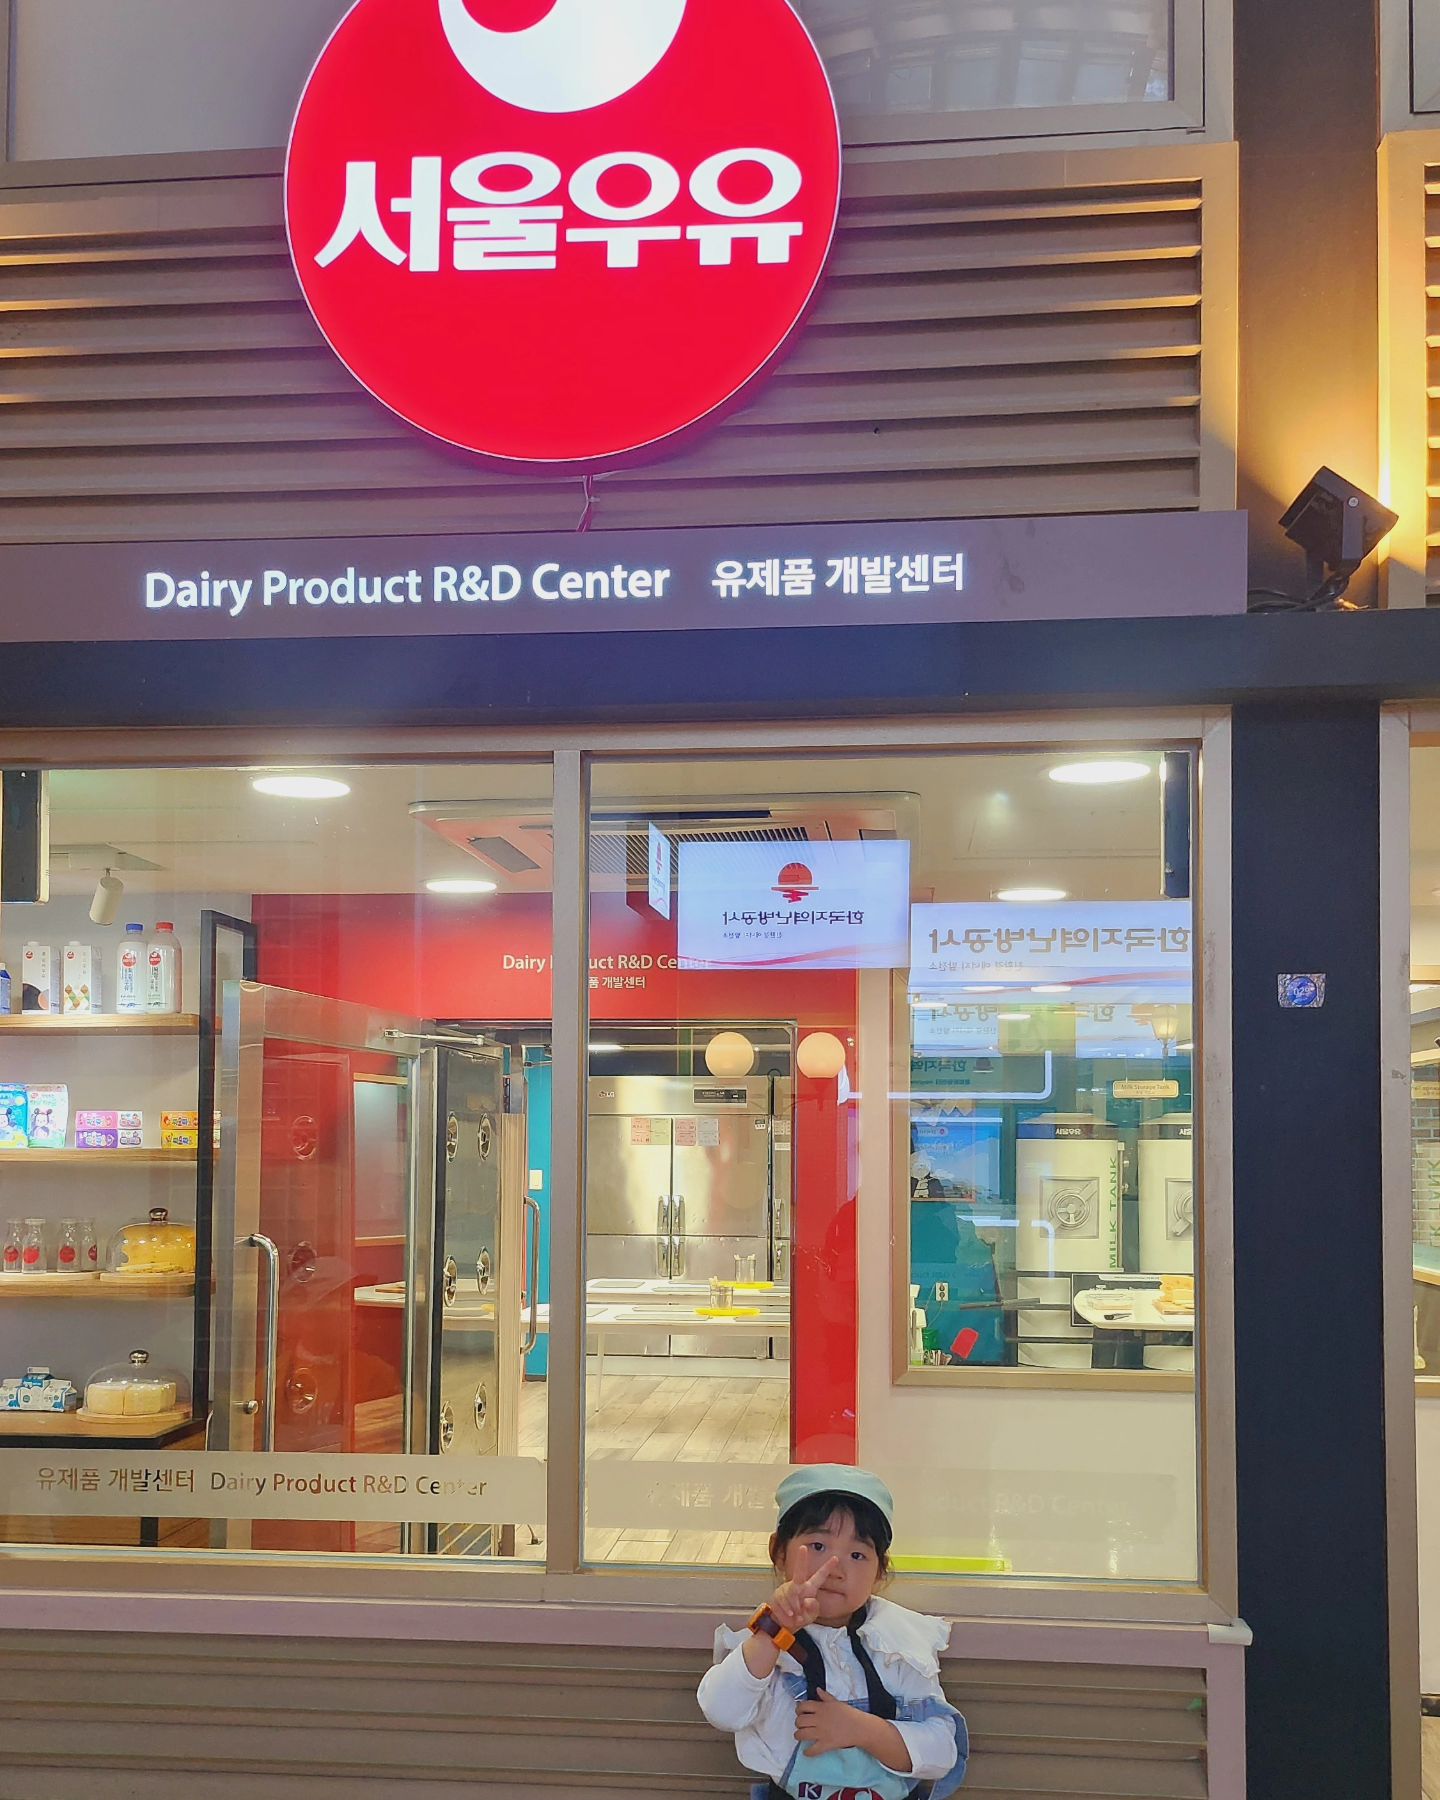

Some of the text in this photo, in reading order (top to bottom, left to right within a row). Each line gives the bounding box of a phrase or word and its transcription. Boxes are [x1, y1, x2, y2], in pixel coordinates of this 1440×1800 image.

[314, 147, 803, 271] 서울우유
[711, 552, 964, 598] 유제품 개발센터
[145, 563, 671, 617] Dairy Product R&D Center
[503, 955, 546, 973] Dairy
[618, 955, 653, 969] R&D
[602, 976, 646, 988] 개발센터
[36, 1467, 195, 1494] 유제품 개발센터
[210, 1471, 267, 1496] Dairy
[273, 1472, 357, 1495] Product
[363, 1475, 407, 1495] R&D
